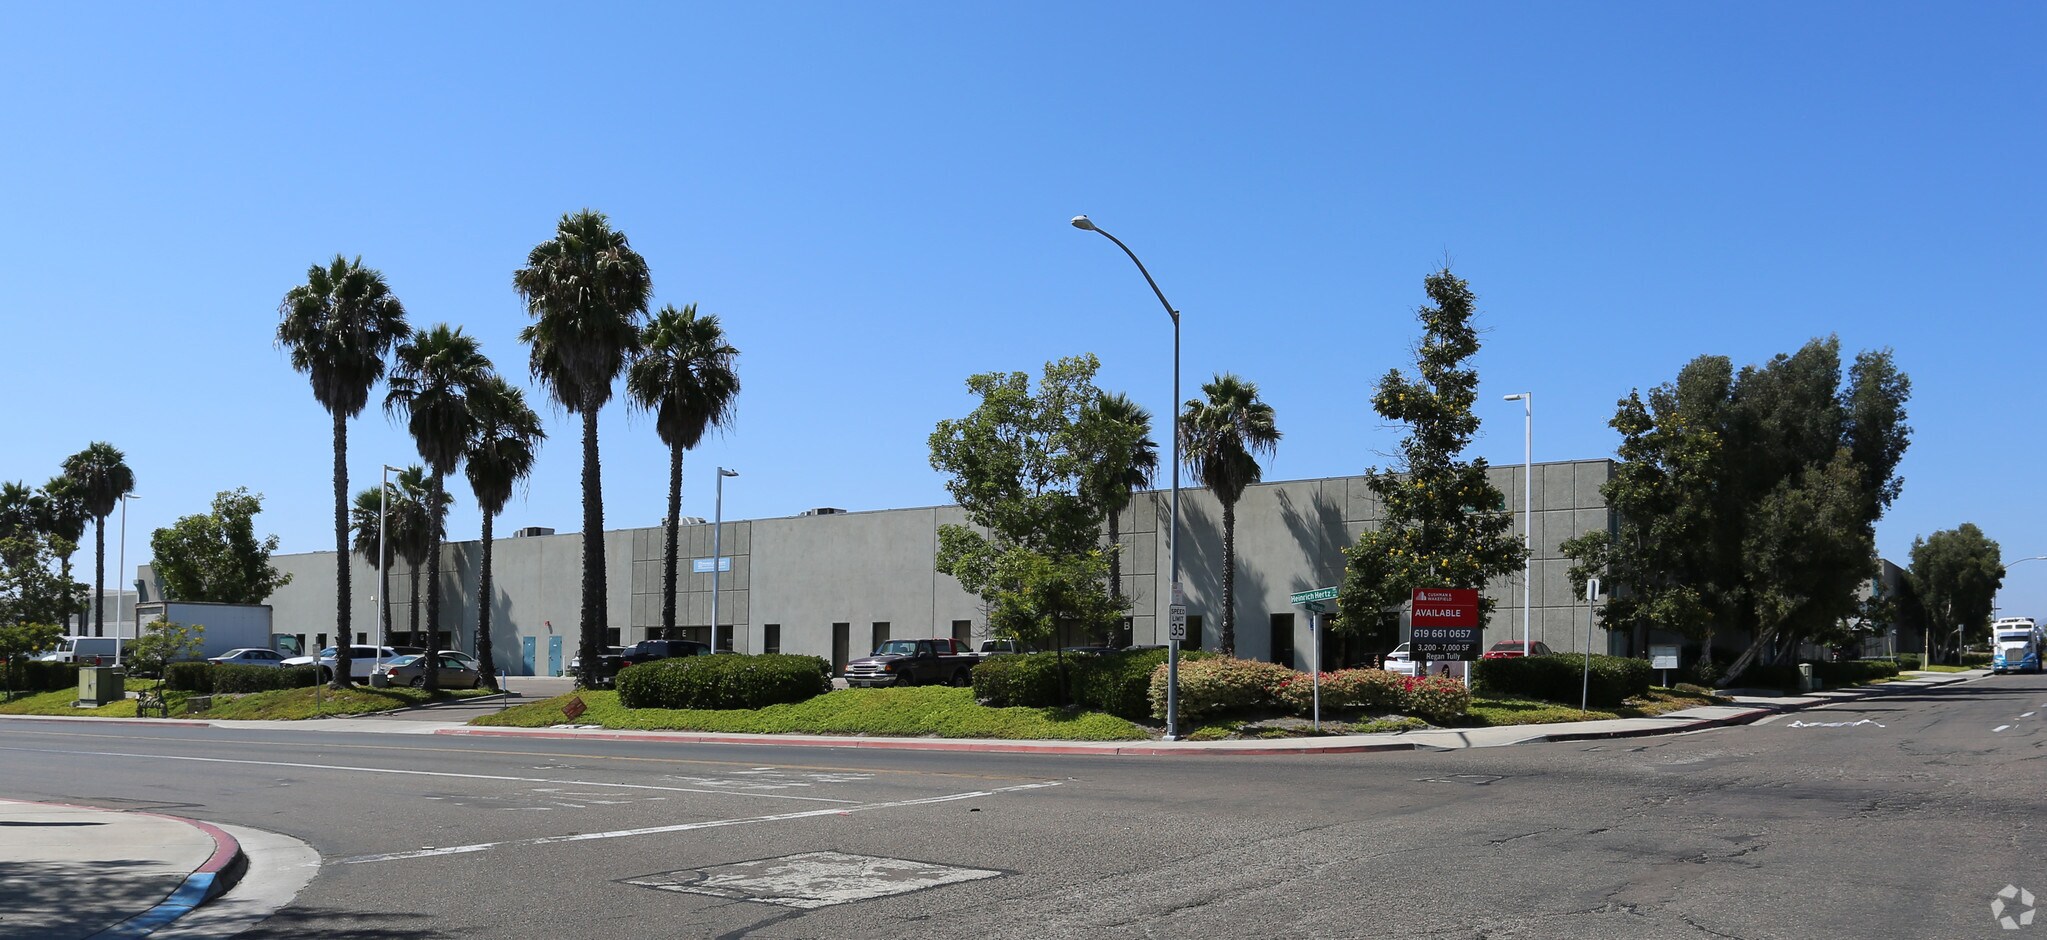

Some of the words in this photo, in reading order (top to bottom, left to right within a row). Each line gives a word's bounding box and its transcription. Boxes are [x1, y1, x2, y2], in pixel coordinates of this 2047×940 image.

[1291, 593, 1314, 603] Heinrich
[1315, 590, 1331, 599] Hertz
[1414, 609, 1461, 617] AVAILABLE
[1124, 621, 1131, 630] B
[1376, 616, 1384, 626] A
[682, 629, 687, 638] E
[1171, 623, 1185, 636] 35
[1413, 629, 1430, 638] 619
[1431, 629, 1447, 638] 661
[1449, 629, 1471, 638] 0657
[1426, 652, 1445, 661] Regan
[1446, 652, 1461, 661] Tully
